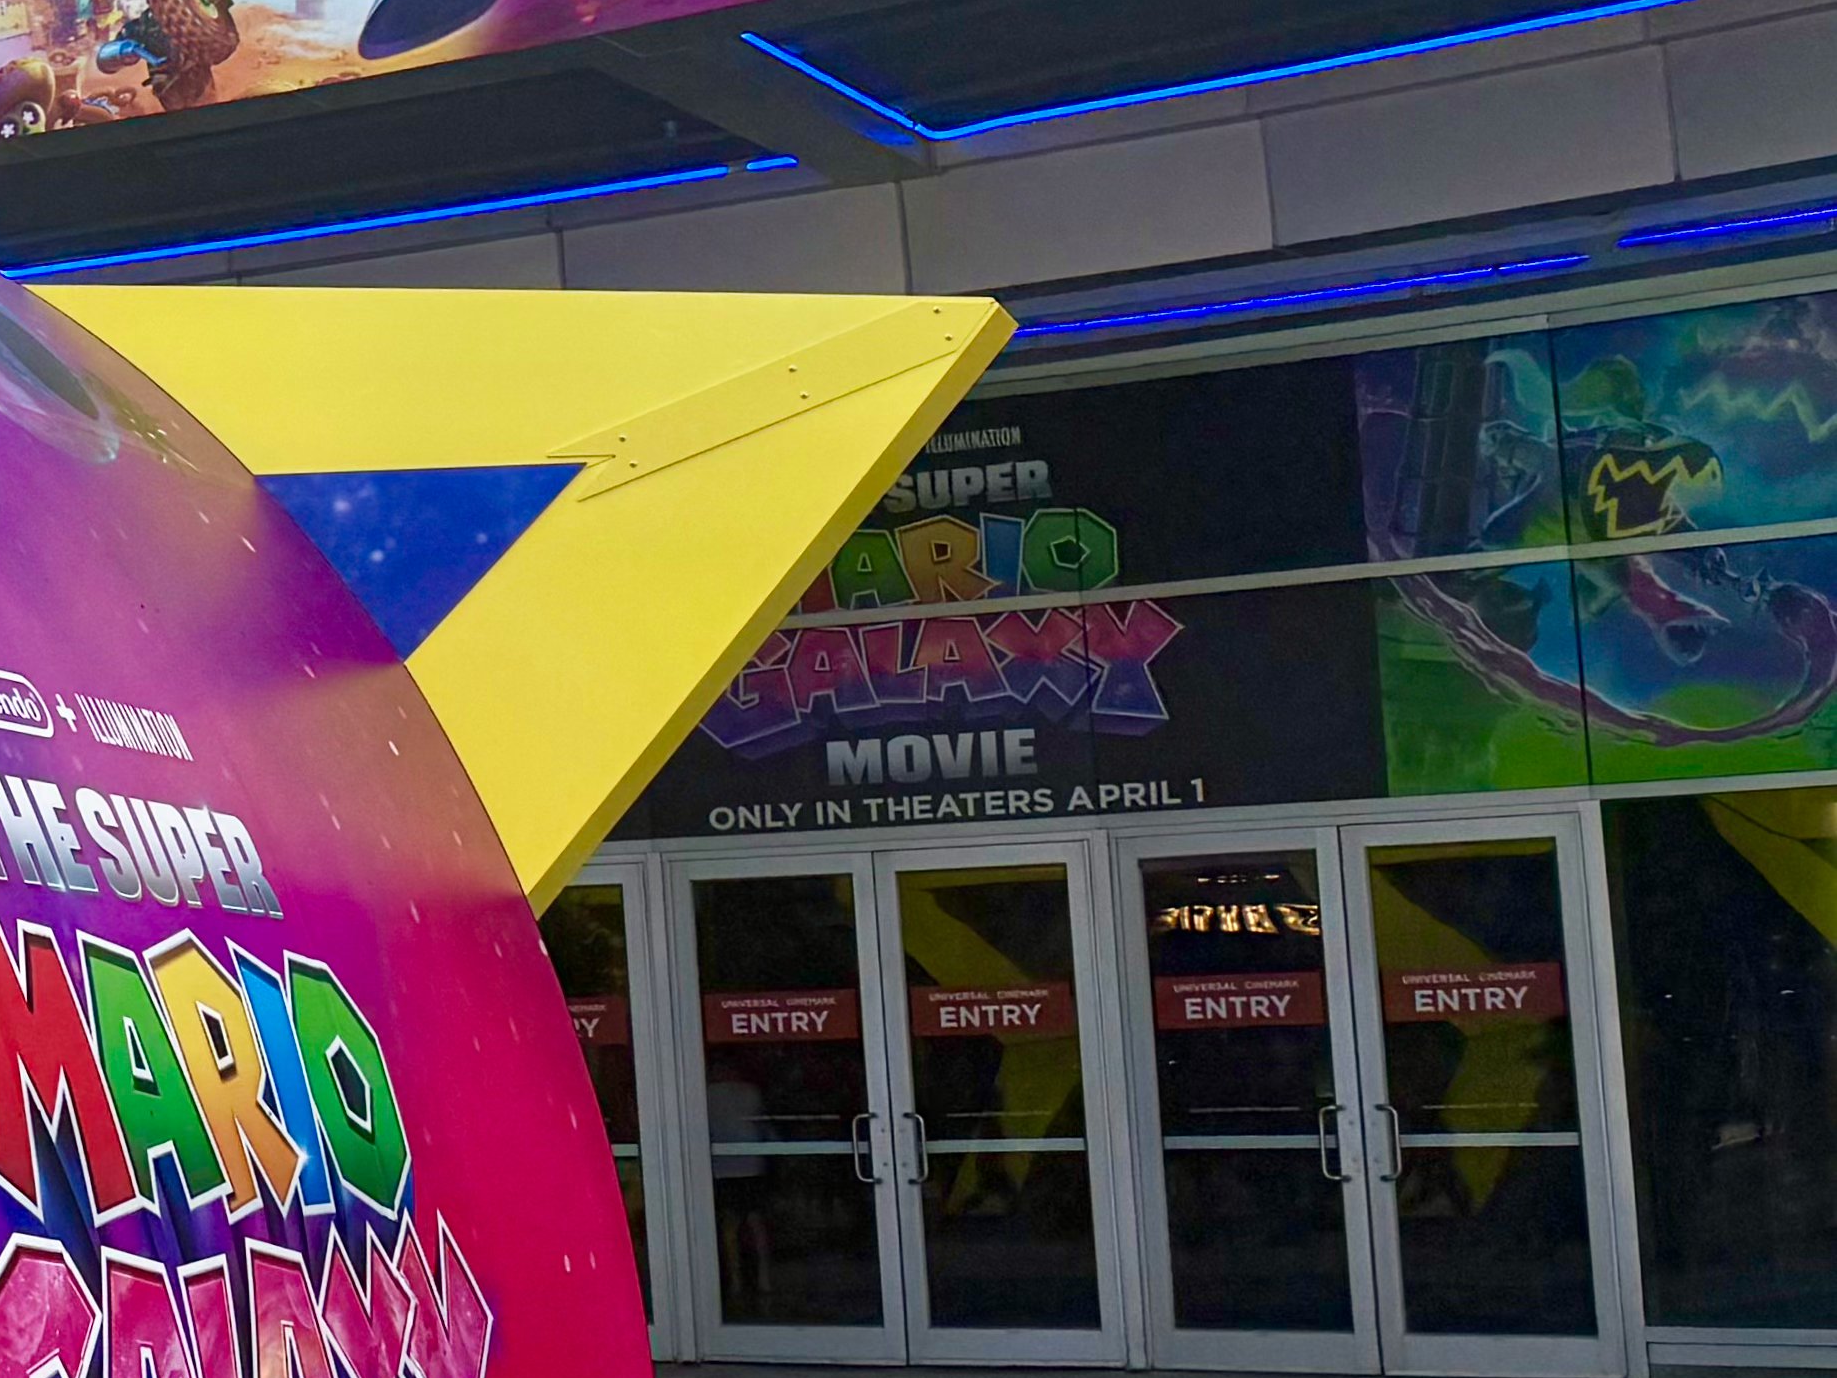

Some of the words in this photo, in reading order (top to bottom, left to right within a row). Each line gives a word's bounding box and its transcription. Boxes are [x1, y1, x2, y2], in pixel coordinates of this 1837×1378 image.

[927, 426, 1022, 454] ILLUMINATION
[884, 460, 1053, 513] SUPER
[802, 508, 1118, 612] ARIO
[699, 599, 1184, 749] GALAXY
[75, 693, 194, 761] ILLUMINATION
[828, 728, 1039, 786] MOVIE
[709, 801, 804, 831] ONLY
[816, 799, 851, 826] IN
[863, 788, 1054, 822] THEATERS
[1068, 780, 1181, 811] APRIL
[1190, 778, 1205, 802] 1
[75, 787, 284, 919] SUPER
[732, 1011, 828, 1034] ENTRY
[939, 1004, 1041, 1028] ENTRY
[1184, 995, 1291, 1020] ENTRY
[1414, 986, 1528, 1013] ENTRY
